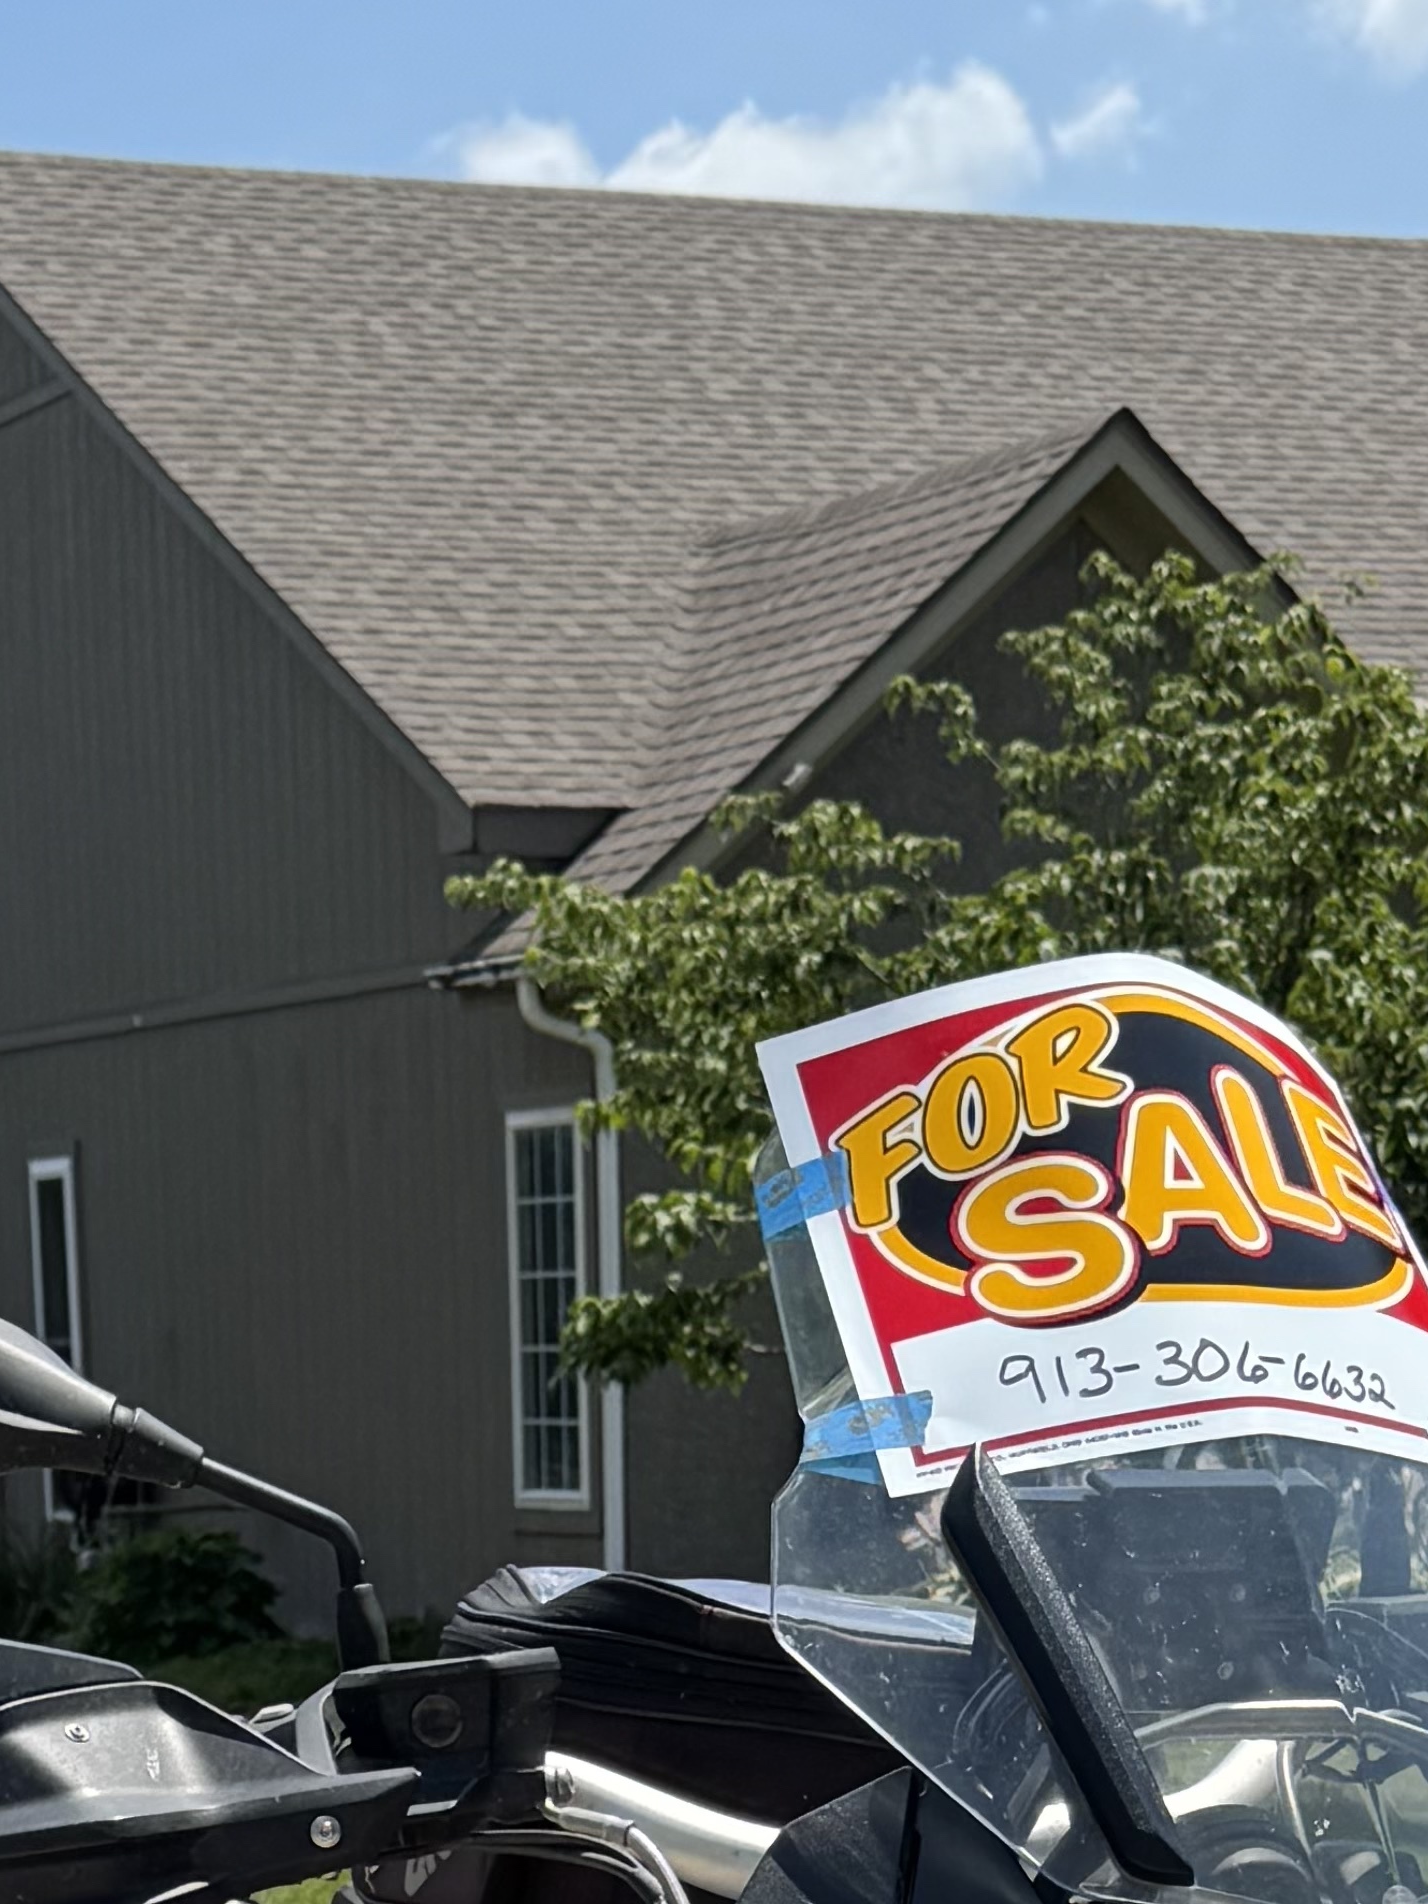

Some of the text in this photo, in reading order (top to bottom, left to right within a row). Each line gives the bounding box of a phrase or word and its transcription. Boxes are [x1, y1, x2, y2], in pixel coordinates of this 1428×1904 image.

[832, 1000, 1128, 1228] FOR
[957, 1065, 1404, 1322] SALE
[999, 1339, 1396, 1410] 913-306-6632
